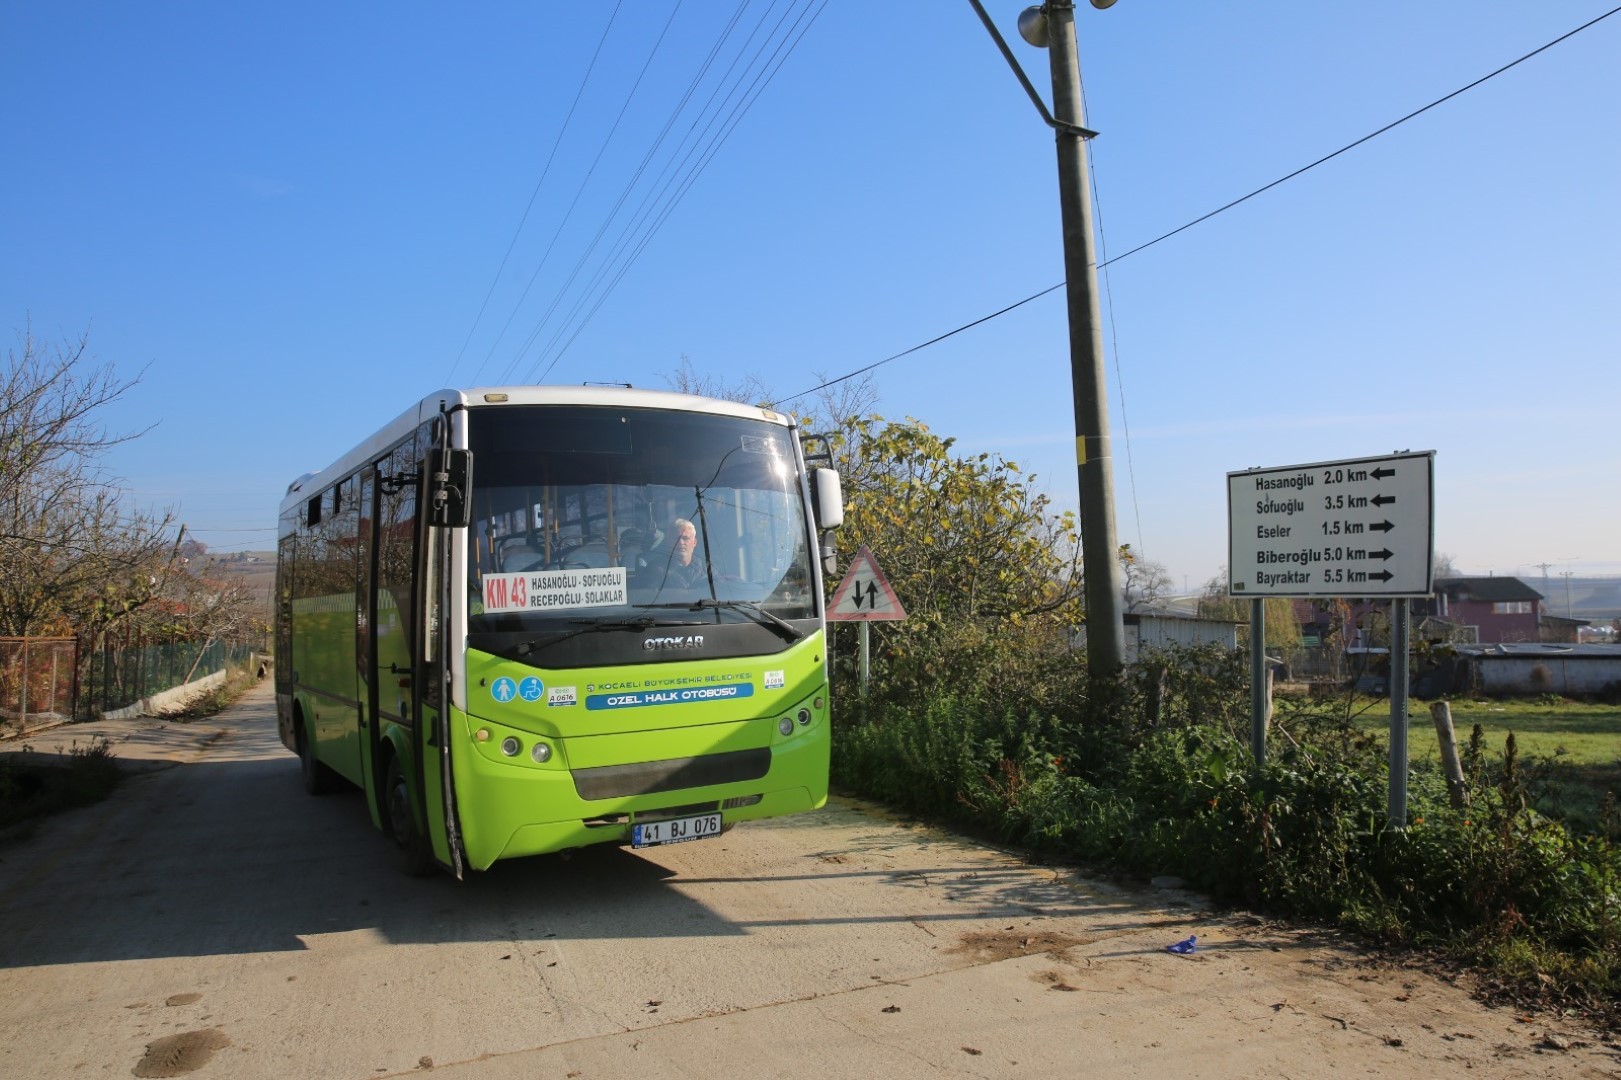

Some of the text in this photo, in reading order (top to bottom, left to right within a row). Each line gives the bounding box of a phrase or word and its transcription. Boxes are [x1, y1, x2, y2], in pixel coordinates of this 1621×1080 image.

[1256, 469, 1367, 490] Hasanoğlu 2.0 km
[1256, 495, 1368, 515] Sofuoğlu 3.5 km
[1257, 520, 1364, 539] Eseler 1.5 km
[1256, 547, 1366, 566] Biberoğlu 5.0 km
[532, 574, 577, 590] HASANOĞLU
[582, 571, 621, 587] SOFUOĞLU
[1256, 569, 1367, 587] Bayraktar 5.5 km
[486, 576, 527, 609] KM 43
[585, 590, 623, 604] SOLAKLAR
[643, 635, 704, 650] OTOKAR
[556, 694, 574, 702] 0616
[645, 691, 679, 703] HALK
[681, 686, 737, 699] OTOBÜSÜ
[644, 817, 717, 841] 41 BJ 076
